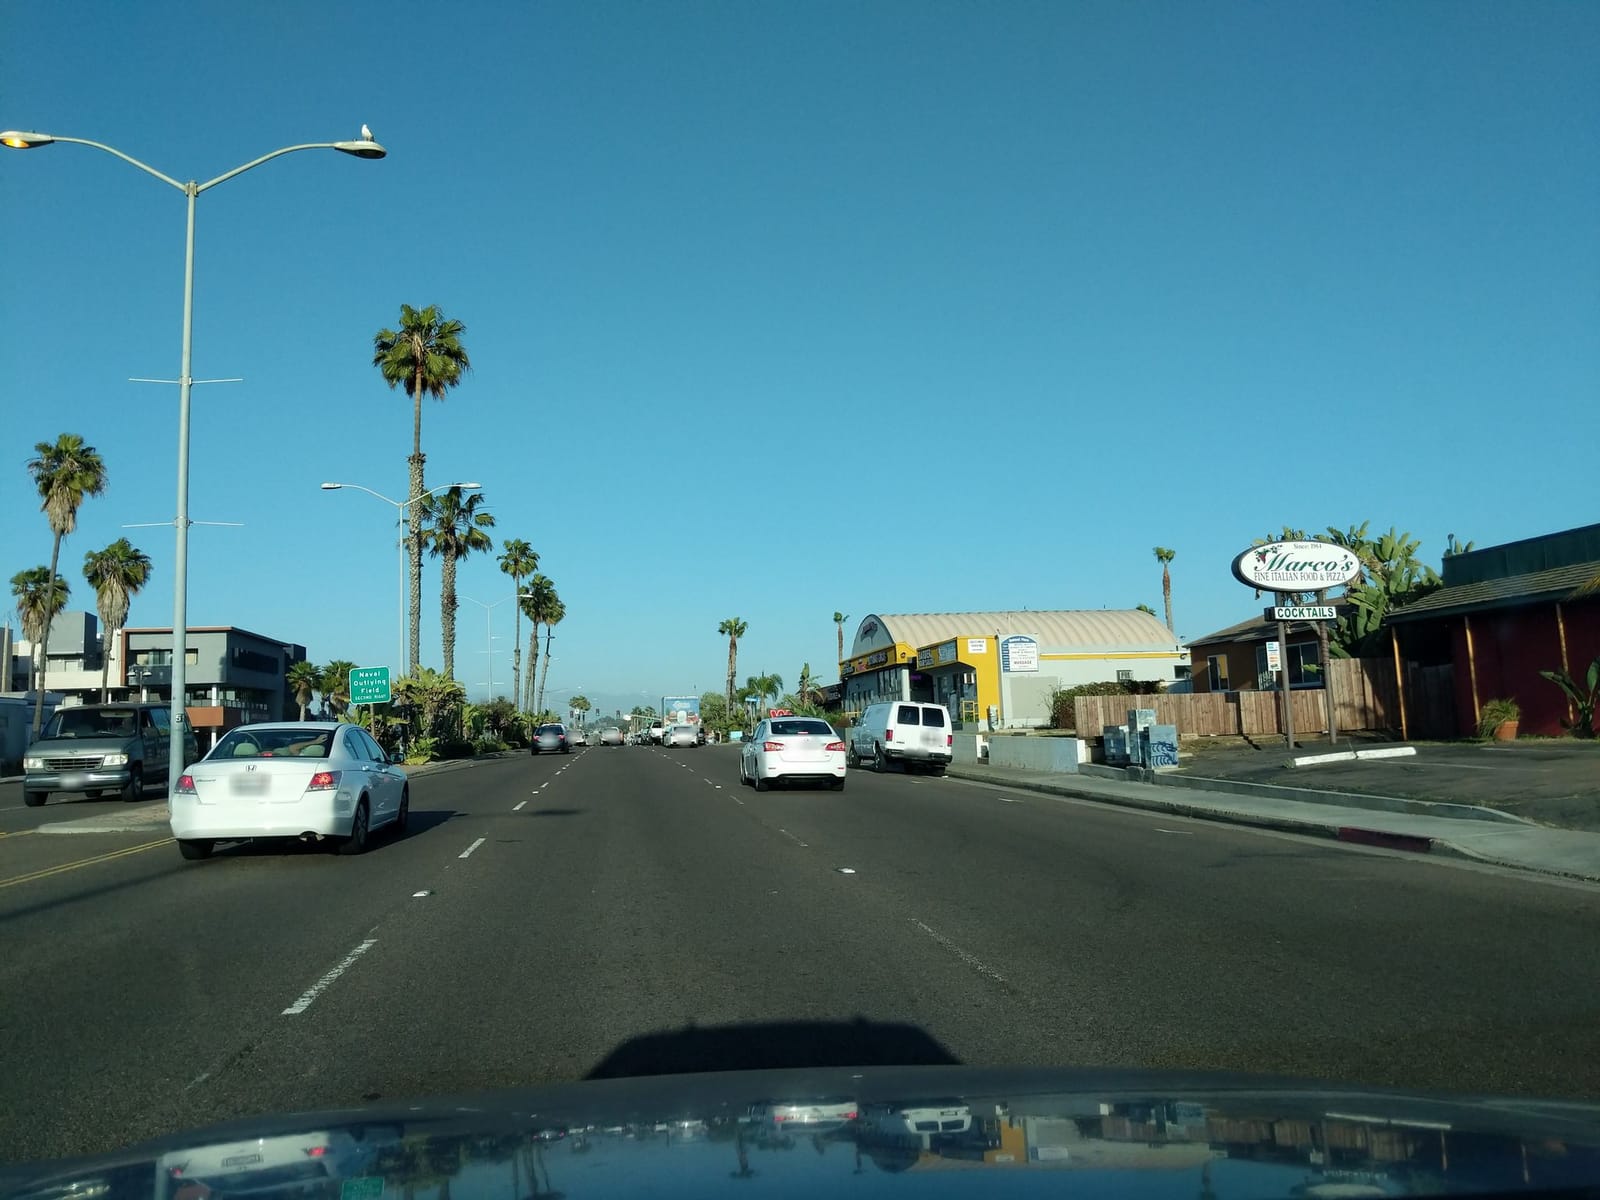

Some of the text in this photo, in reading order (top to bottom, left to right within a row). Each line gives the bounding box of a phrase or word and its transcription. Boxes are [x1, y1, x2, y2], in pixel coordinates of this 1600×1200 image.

[1254, 552, 1354, 572] Marco's
[1254, 572, 1346, 581] FINE ITALIAN FOOD & PIZZA
[1277, 607, 1334, 618] COCKTAILS
